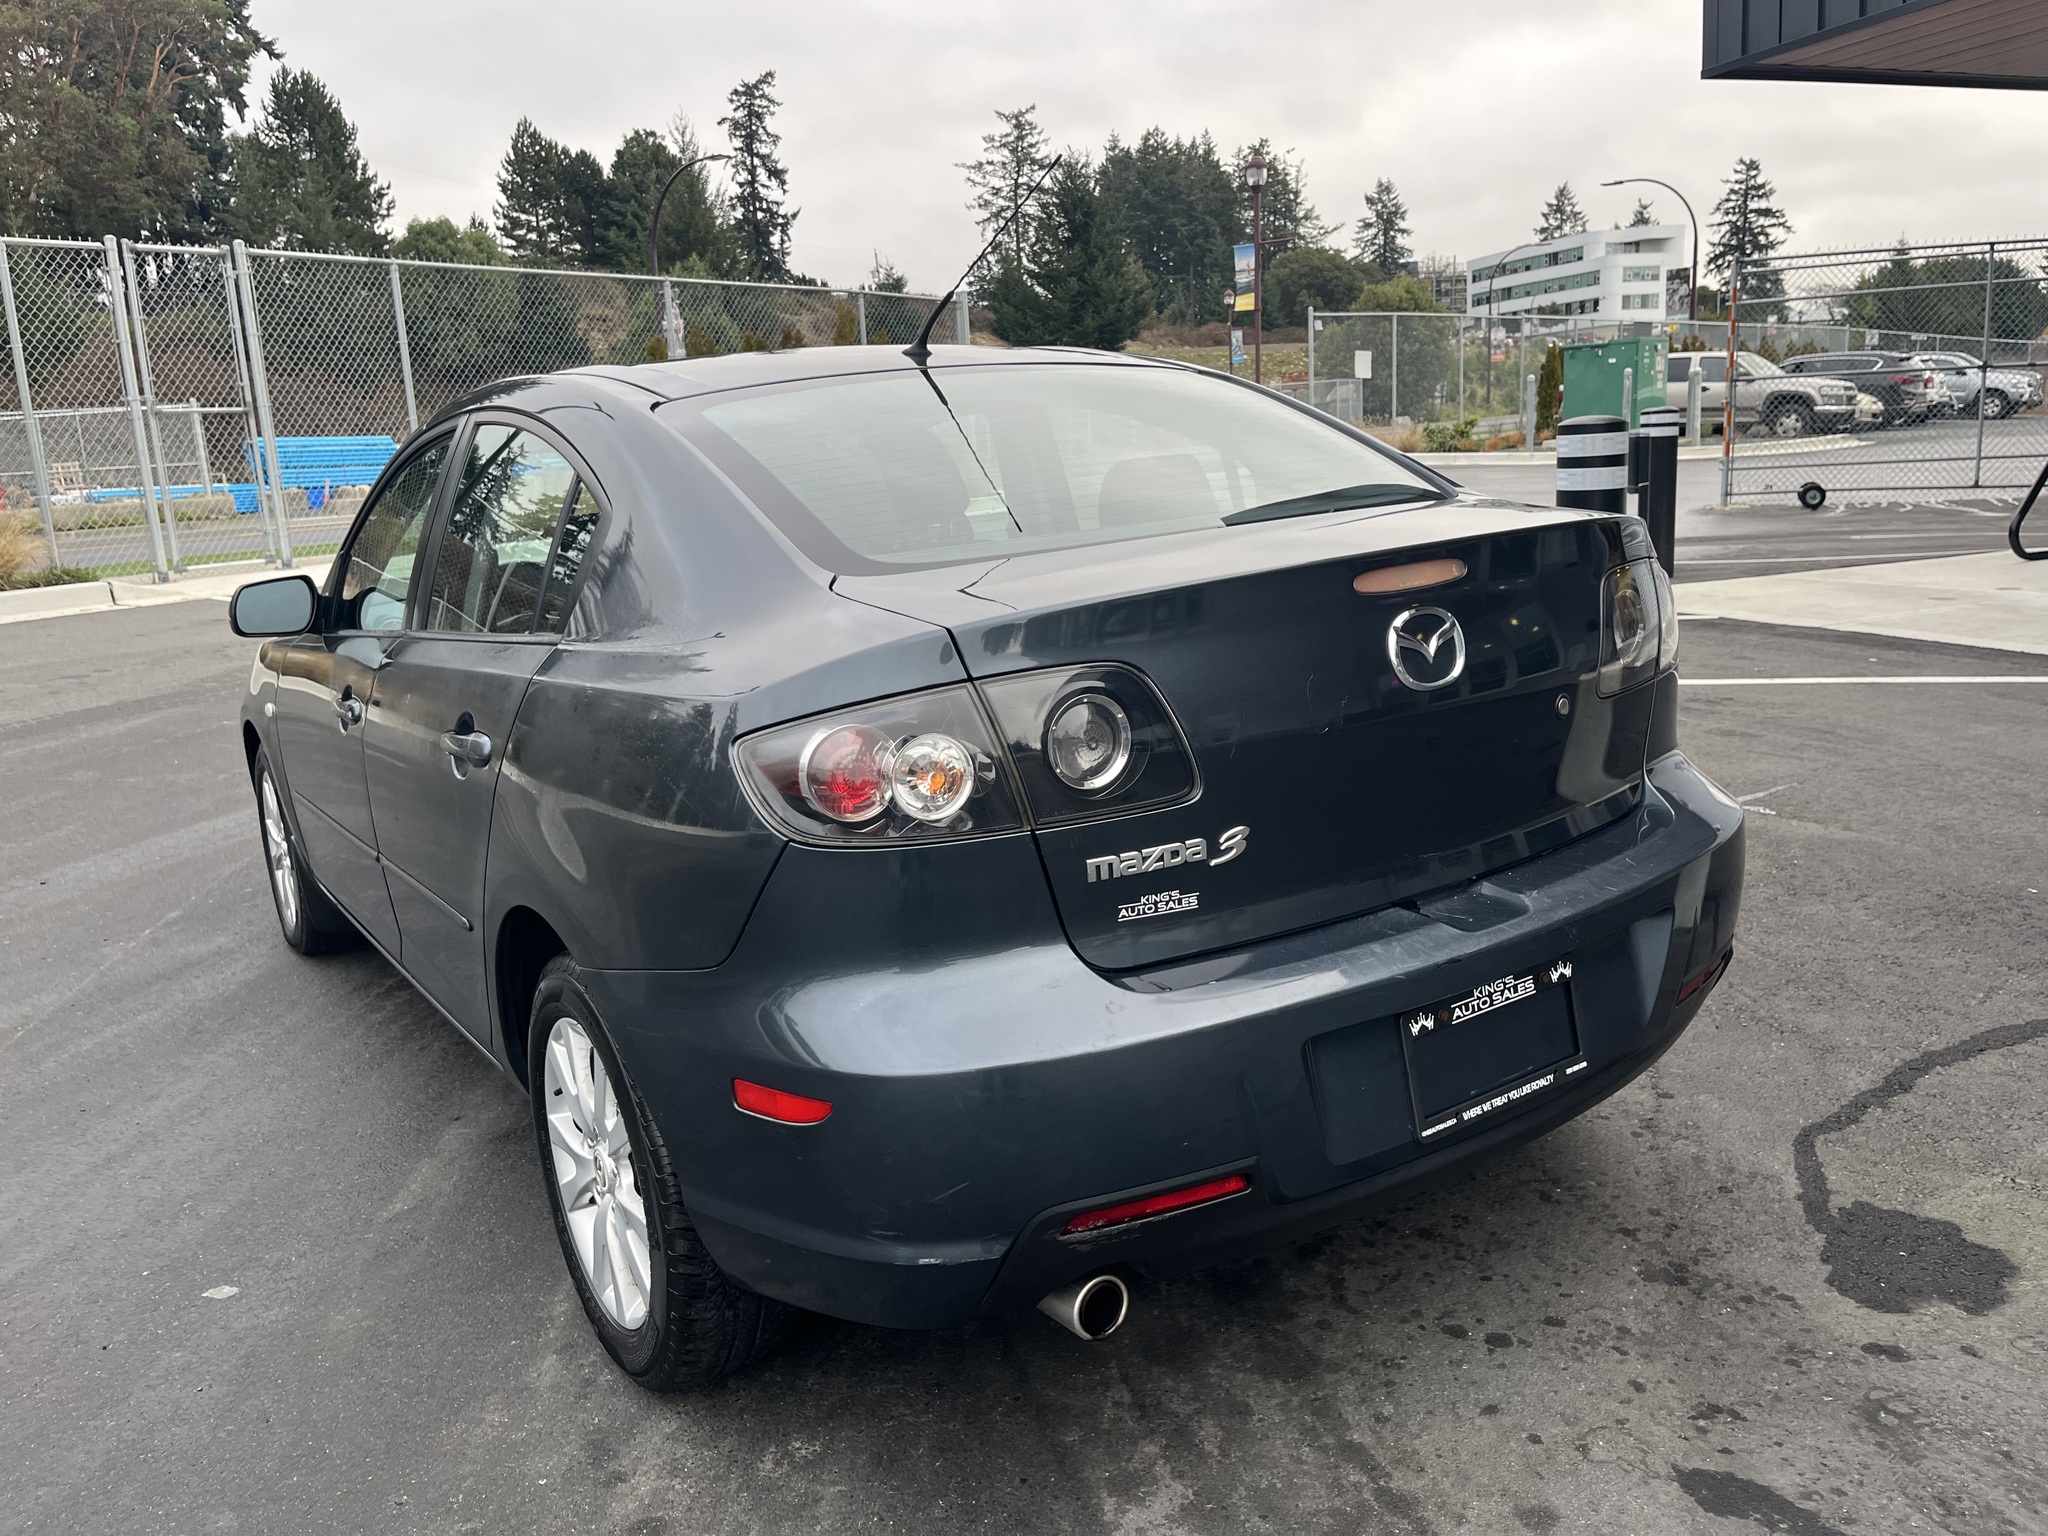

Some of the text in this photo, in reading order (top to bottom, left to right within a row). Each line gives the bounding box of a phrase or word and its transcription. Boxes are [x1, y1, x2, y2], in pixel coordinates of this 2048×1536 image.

[1208, 825, 1251, 867] 3
[1118, 896, 1198, 919] AUTO SALES
[1140, 889, 1180, 905] KING'S
[1452, 979, 1535, 1020] AUTO SALES
[1473, 974, 1515, 999] KING'S
[1462, 1073, 1554, 1121] WHERE WE TREAT YOU LIKE ROYALTY
